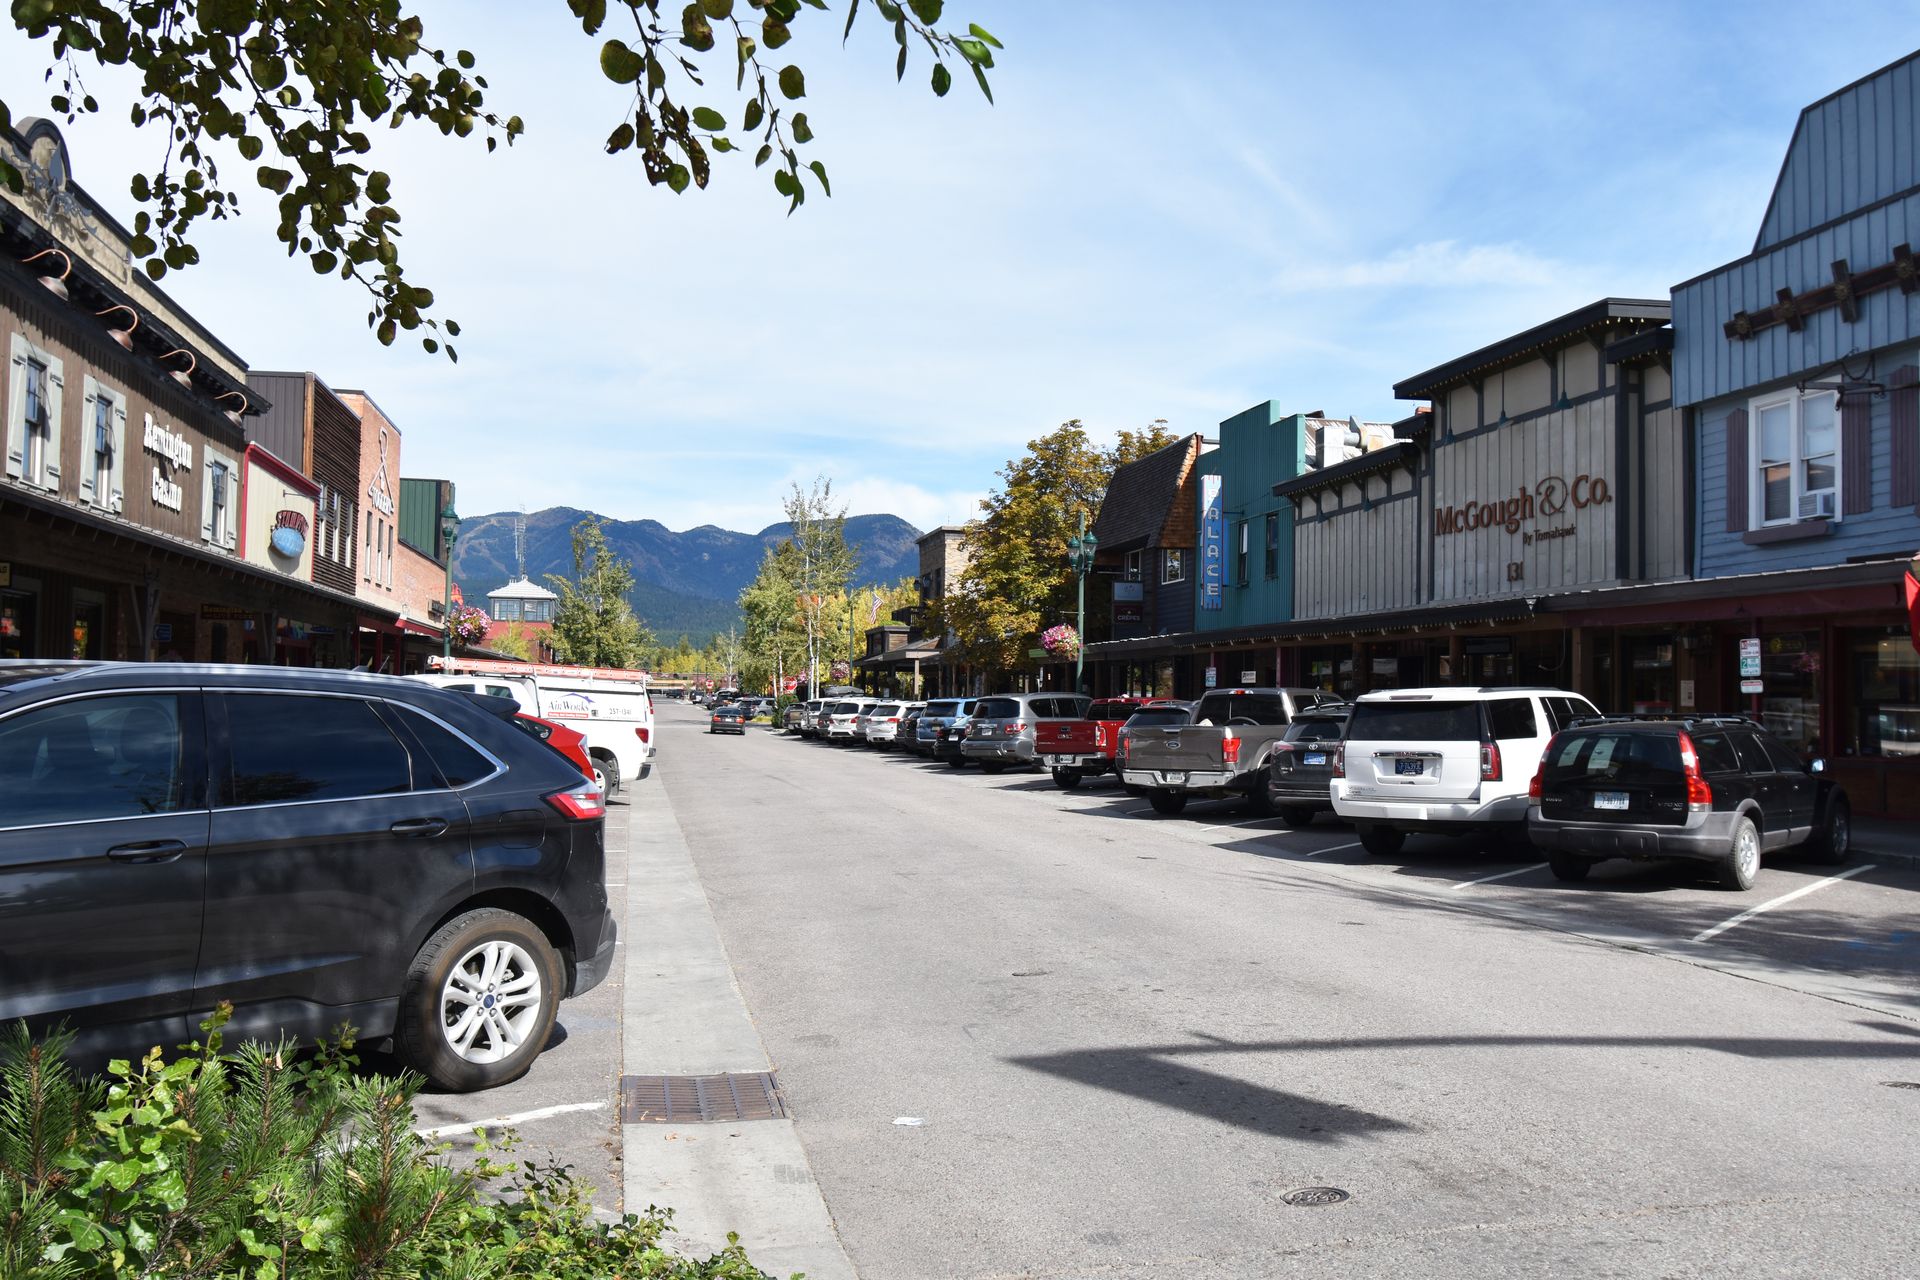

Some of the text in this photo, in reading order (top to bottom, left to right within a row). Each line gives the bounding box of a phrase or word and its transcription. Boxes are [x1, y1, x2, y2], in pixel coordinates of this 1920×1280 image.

[143, 411, 193, 470] Remington
[151, 466, 183, 512] Casino
[1435, 474, 1613, 536] McGough & Co.
[1206, 488, 1220, 596] PALACE
[1522, 523, 1577, 547] By Tomahawk
